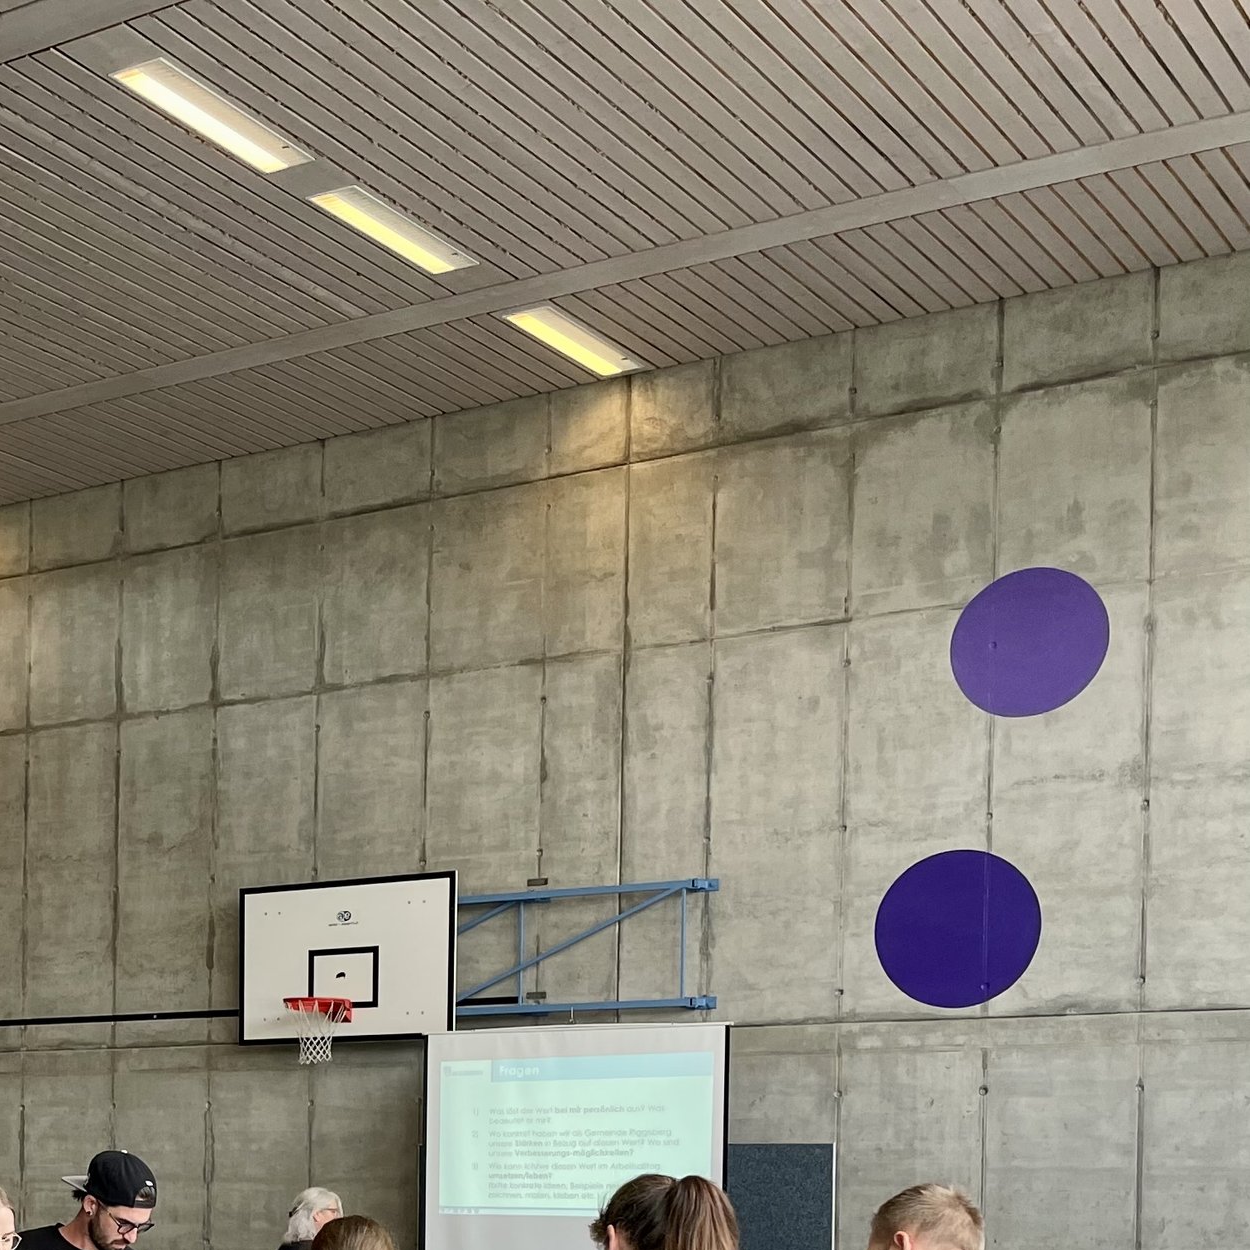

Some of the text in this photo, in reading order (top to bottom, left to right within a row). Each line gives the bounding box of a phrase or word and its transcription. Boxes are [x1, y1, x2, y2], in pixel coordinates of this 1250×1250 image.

[499, 1063, 540, 1078] Fragen
[554, 1105, 567, 1113] bei
[569, 1104, 581, 1113] mir
[583, 1104, 625, 1115] persönlich
[532, 1130, 558, 1138] haben
[584, 1128, 627, 1137] Gemeinde
[553, 1139, 577, 1149] Bezug
